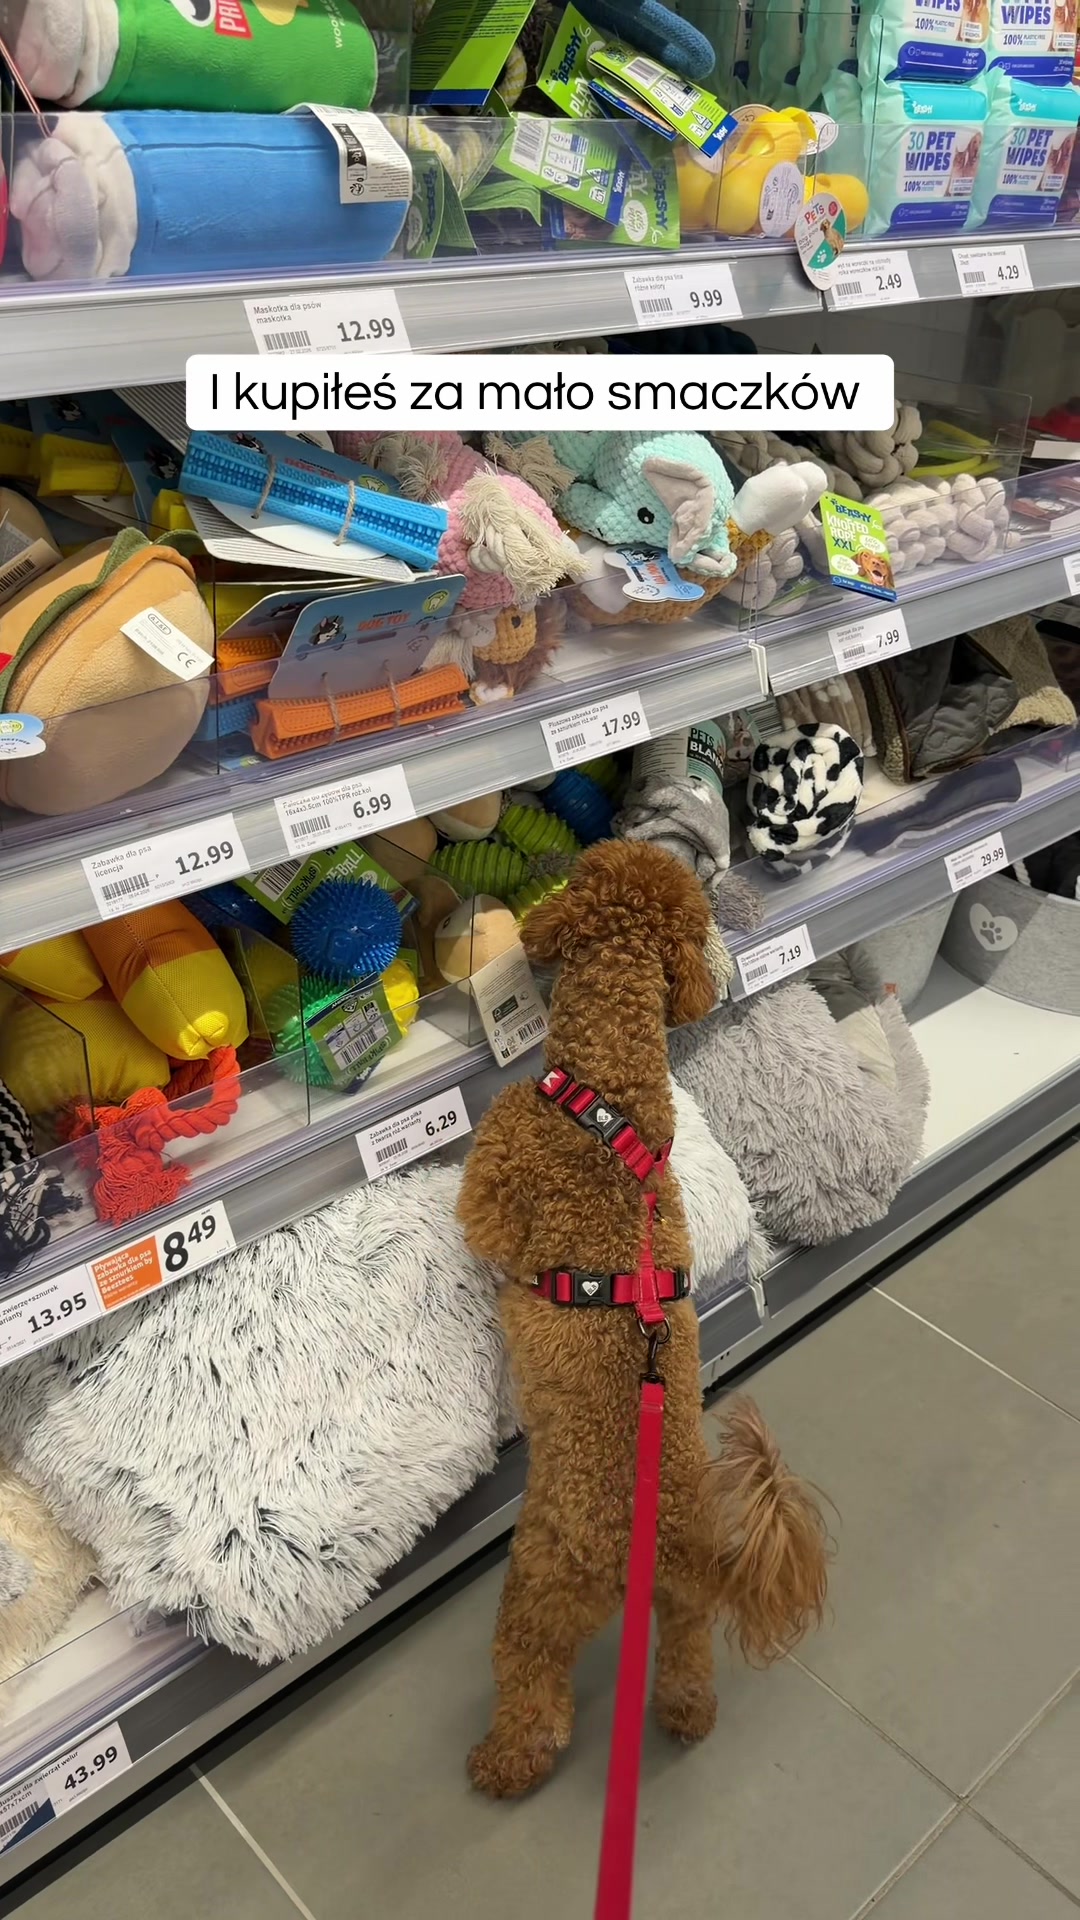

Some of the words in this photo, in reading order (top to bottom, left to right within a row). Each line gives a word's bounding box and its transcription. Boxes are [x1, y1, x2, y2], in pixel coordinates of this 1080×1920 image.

[915, 18, 934, 31] 100%
[1001, 6, 1051, 25] WIPES
[1003, 34, 1023, 46] 100%
[557, 27, 582, 85] BEASTY
[908, 131, 925, 150] 30
[926, 131, 956, 150] PET
[1010, 127, 1026, 146] 30
[1026, 128, 1054, 148] PET
[905, 152, 952, 171] WIPES
[1005, 147, 1047, 167] WIPES
[904, 181, 921, 192] 100%
[1002, 174, 1018, 185] 100%
[804, 202, 825, 224] PETS
[876, 273, 902, 291] 2.49
[998, 265, 1019, 280] 4.29
[253, 303, 289, 314] Maskotka
[290, 302, 301, 311] dla
[302, 301, 322, 312] psów
[690, 289, 723, 309] 9.99
[256, 314, 292, 324] maskotka
[337, 317, 396, 343] 12.99
[826, 511, 869, 534] KNOTTED
[835, 504, 872, 522] BEASTY
[830, 527, 856, 542] ROPE
[832, 537, 855, 552] XXL
[876, 629, 900, 648] 7.99
[177, 651, 197, 669] CE
[602, 711, 641, 737] 17.99
[691, 727, 715, 747] PETS
[353, 793, 391, 819] 6.99
[91, 854, 125, 869] Zabawka
[125, 849, 137, 859] dla
[138, 844, 152, 856] psa
[175, 841, 234, 875] 12.99
[981, 847, 1004, 867] 29.99
[94, 863, 124, 878] licencja
[287, 866, 317, 903] SPIKEBALL
[779, 945, 801, 965] 7.19
[369, 1125, 392, 1139] Zabawka
[392, 1120, 400, 1128] dla
[400, 1116, 410, 1125] psa
[410, 1110, 422, 1121] piłka
[425, 1110, 457, 1136] 6.29
[375, 1132, 392, 1143] twarzą
[94, 1252, 129, 1273] Pływająca
[97, 1262, 127, 1280] zabawka
[127, 1256, 139, 1266] dla
[139, 1250, 152, 1262] psa
[99, 1280, 108, 1288] ze
[108, 1262, 144, 1284] sznurkiem
[144, 1256, 153, 1267] by
[101, 1275, 134, 1294] Beeztees
[28, 1291, 87, 1334] 13.95
[22, 1782, 33, 1791] dla
[34, 1764, 61, 1785] zwierząt
[61, 1751, 79, 1766] welur
[64, 1746, 118, 1791] 43.99
